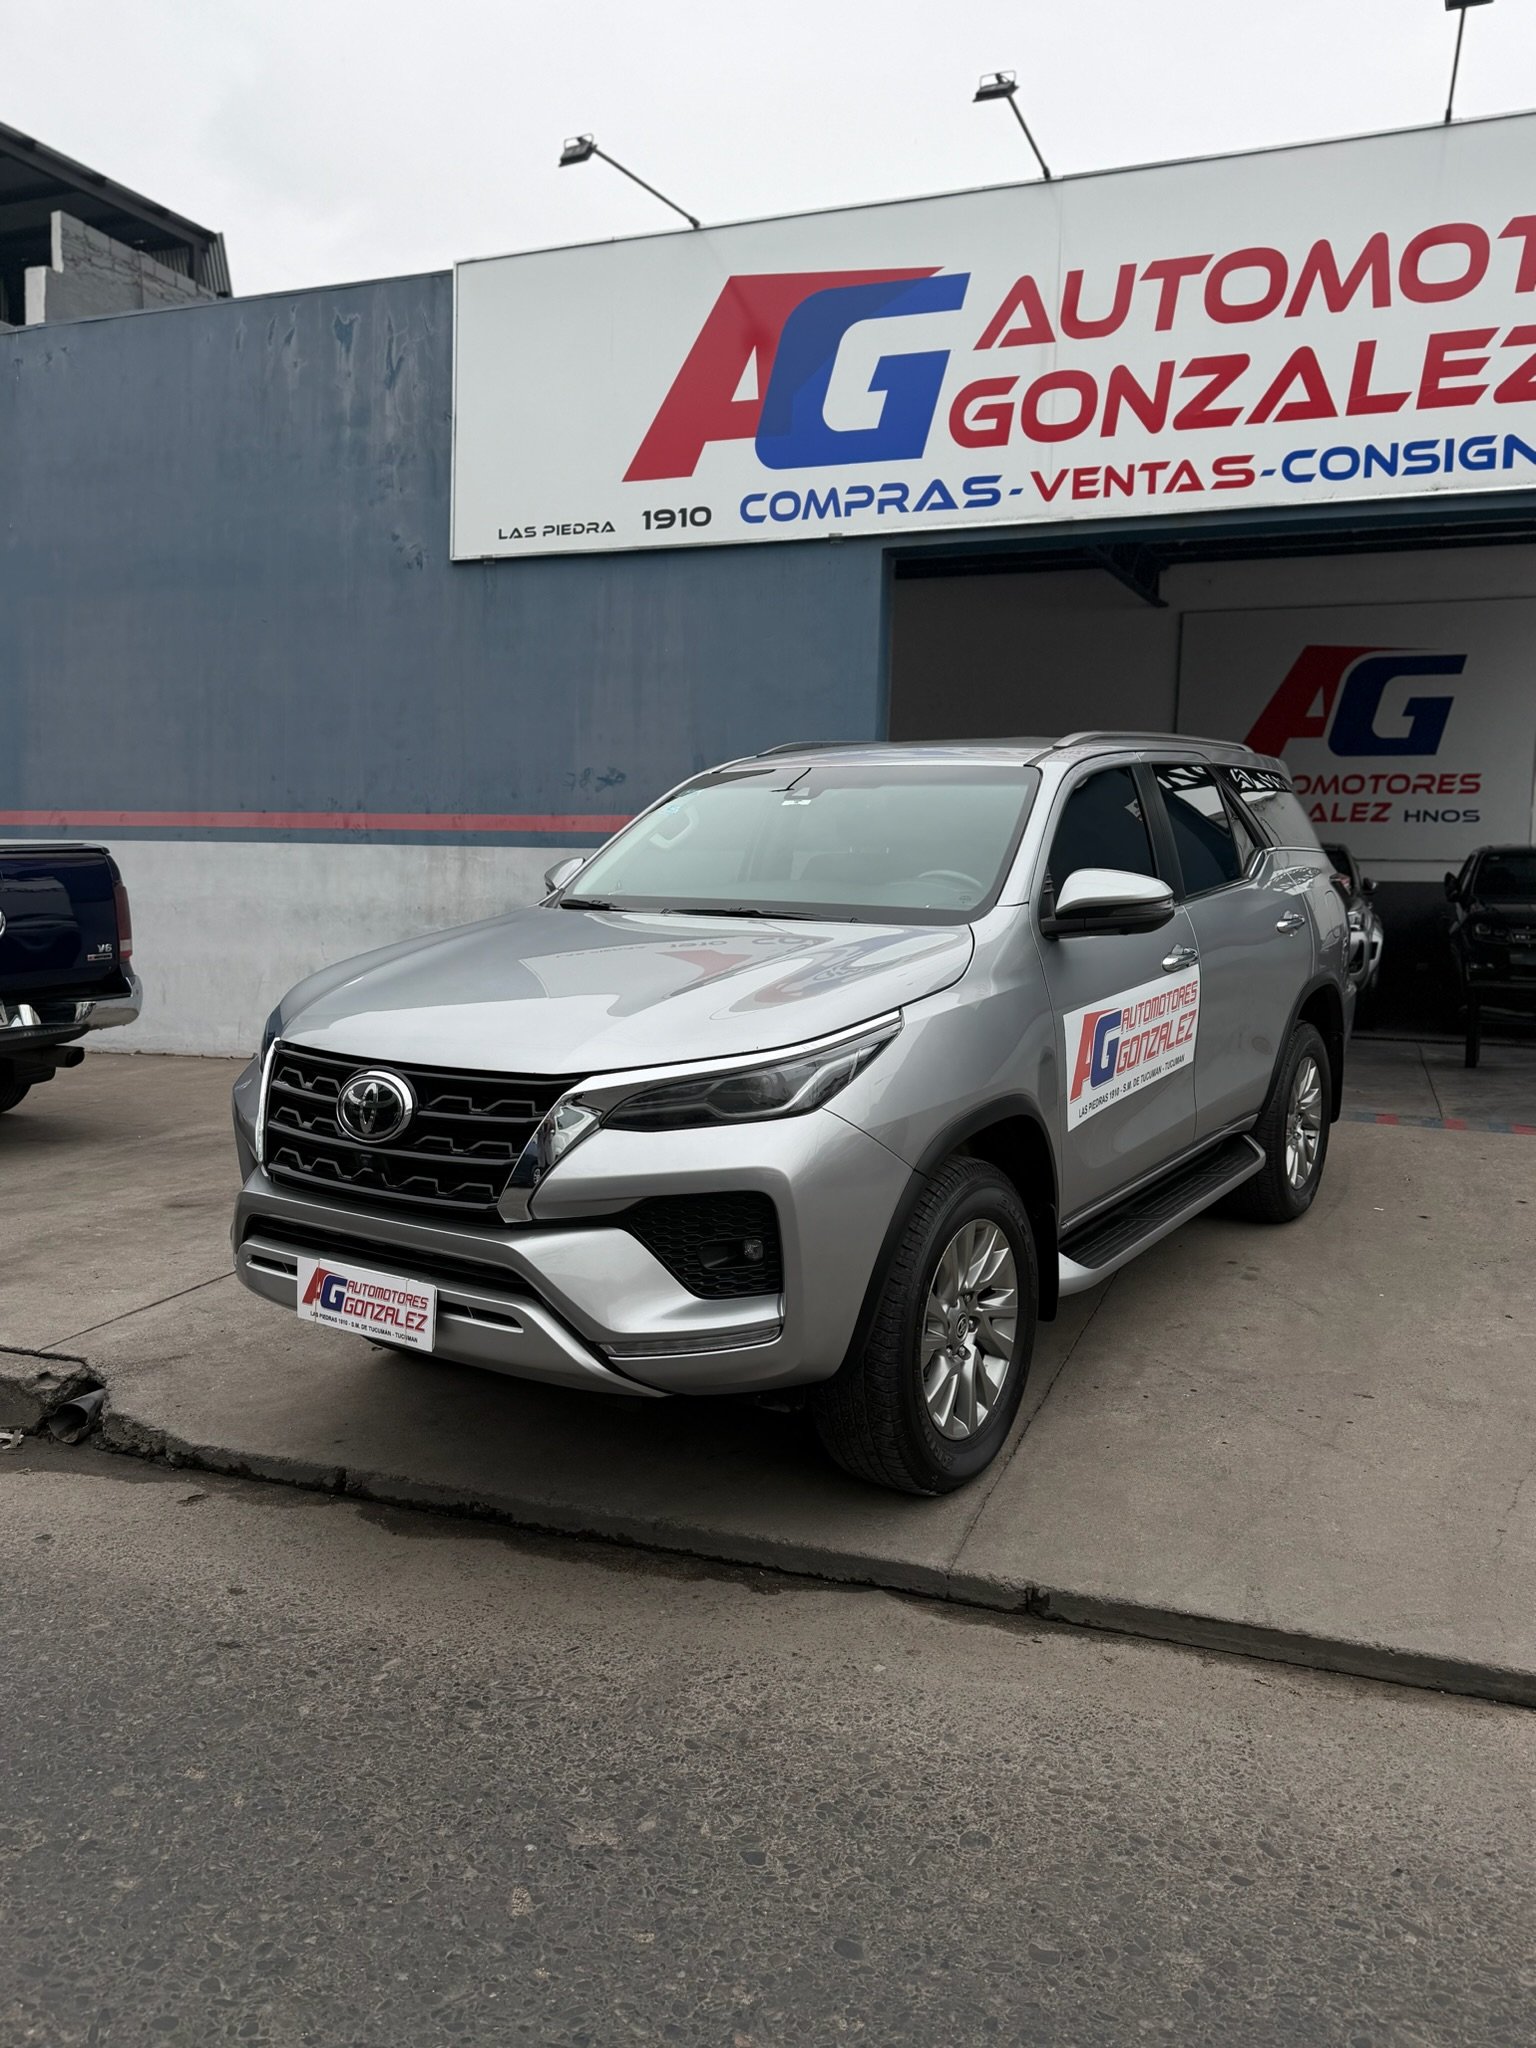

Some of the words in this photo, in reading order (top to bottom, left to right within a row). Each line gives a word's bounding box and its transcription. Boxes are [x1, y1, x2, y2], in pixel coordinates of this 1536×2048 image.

[622, 266, 971, 482] AG
[498, 526, 536, 540] LAS
[542, 521, 616, 537] PIEDRA
[642, 506, 712, 530] 1910
[1243, 645, 1468, 757] AG
[1404, 809, 1481, 823] HNOS
[1121, 980, 1198, 1033] AUTOMOTORES
[1069, 1008, 1122, 1103] AG
[1116, 1009, 1198, 1075] GONZALEZ
[1079, 1104, 1088, 1118] LAS
[1088, 1093, 1109, 1112] PIEDRAS
[1133, 1076, 1140, 1087] DE
[302, 1267, 348, 1312] AG
[346, 1280, 429, 1309] AUTOMOTORES
[319, 1312, 338, 1323] PIEDRAS
[343, 1296, 428, 1332] GONZALEZ
